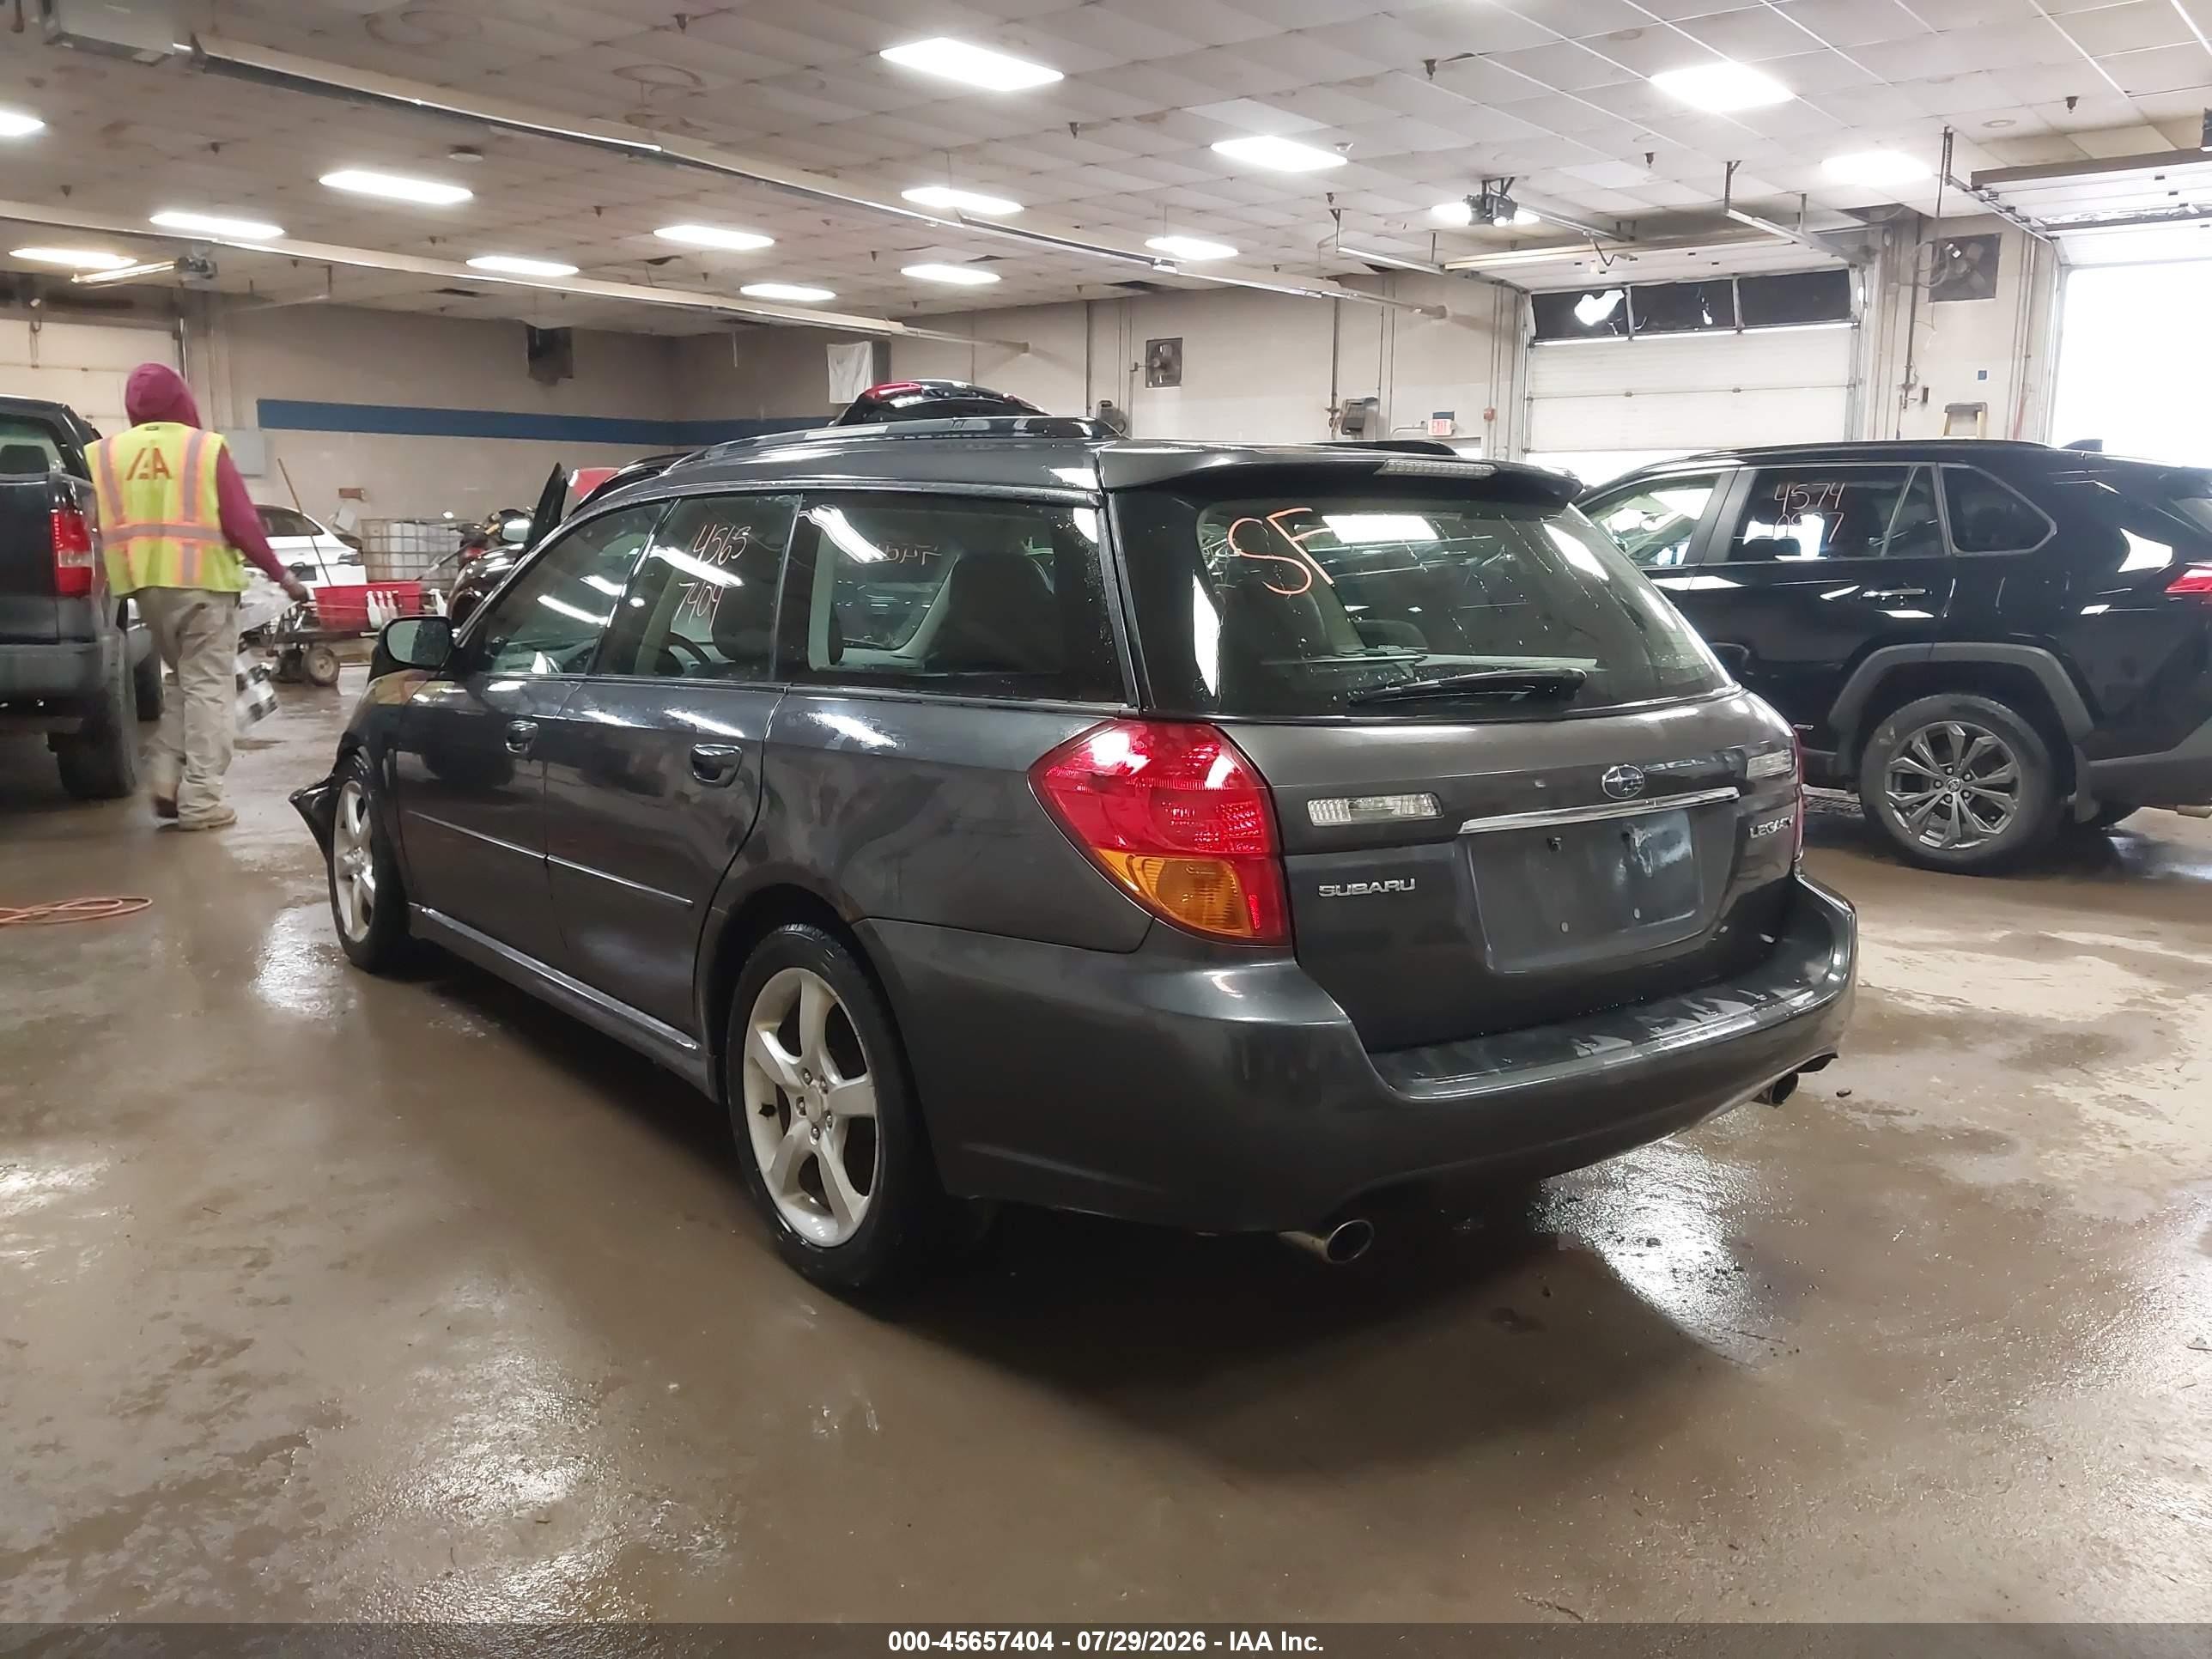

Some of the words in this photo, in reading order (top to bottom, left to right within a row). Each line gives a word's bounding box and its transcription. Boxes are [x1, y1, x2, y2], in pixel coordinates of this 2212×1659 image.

[1774, 482, 1845, 514] 4574
[693, 523, 751, 565] 4565
[1228, 507, 1334, 594] SF
[673, 580, 725, 631] 7404
[1750, 815, 1794, 839] LEGACY
[1318, 878, 1416, 897] SUBARU
